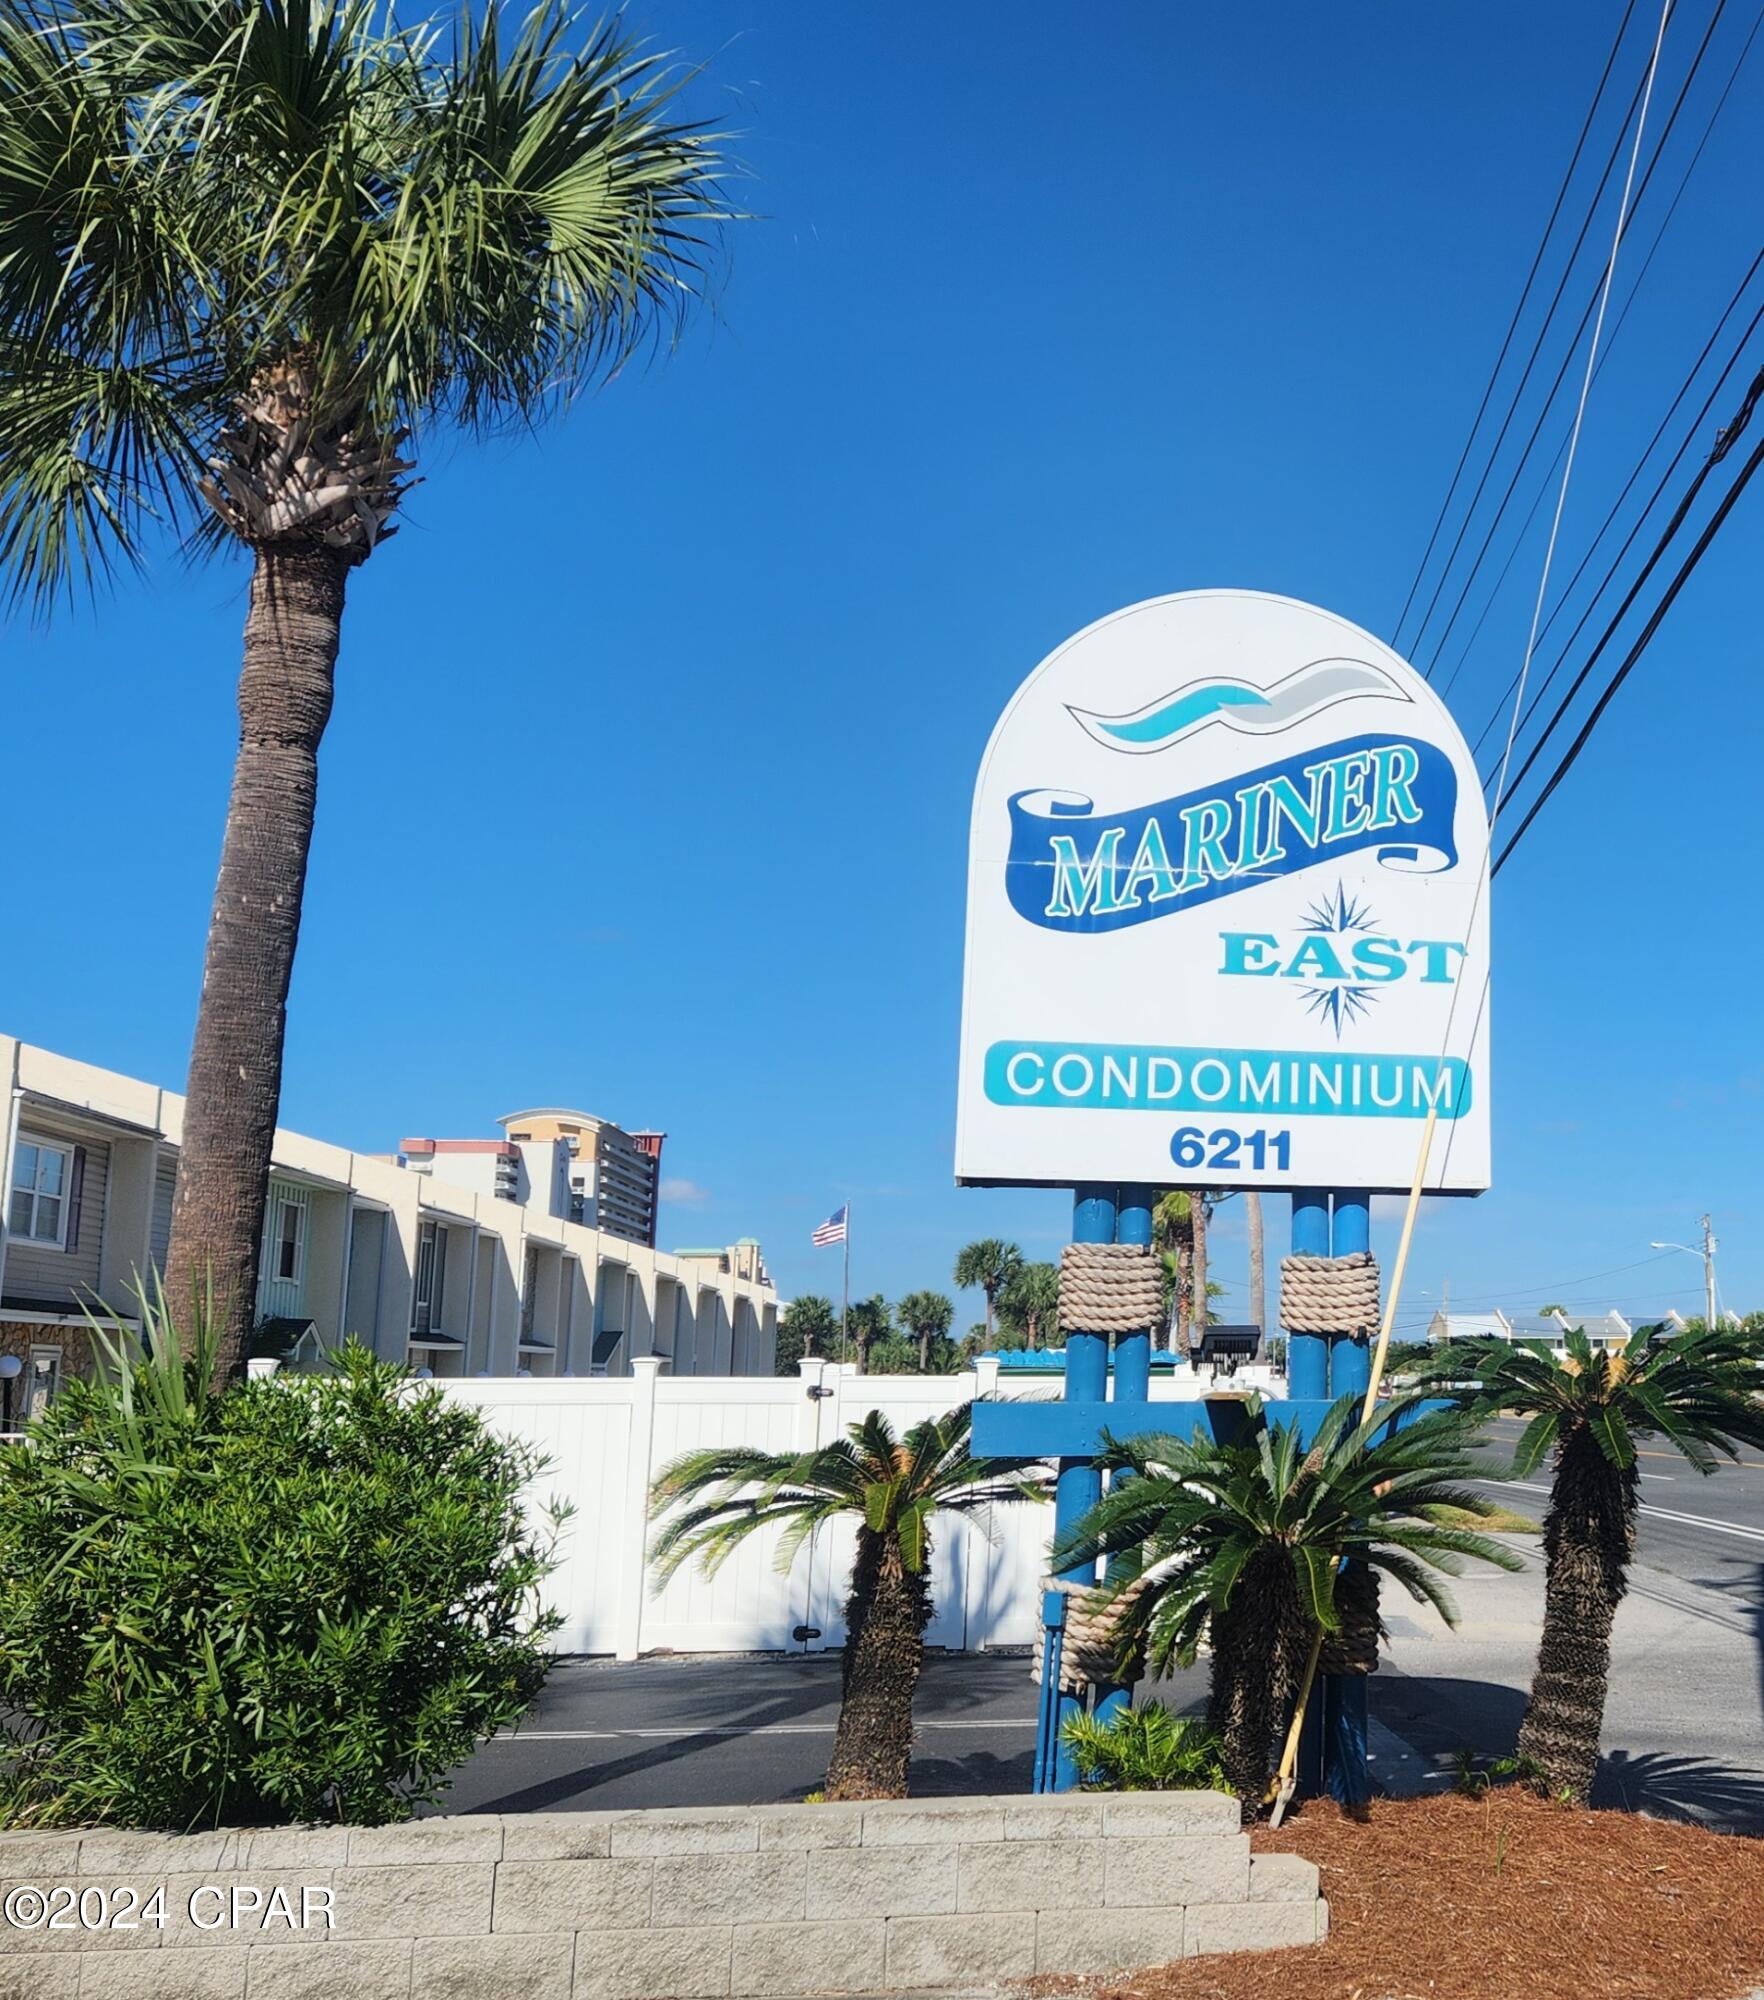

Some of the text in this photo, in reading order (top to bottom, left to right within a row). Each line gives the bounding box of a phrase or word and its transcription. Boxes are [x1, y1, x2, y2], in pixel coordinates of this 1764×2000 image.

[1044, 743, 1424, 918] MARINER
[1217, 933, 1468, 984] EAST
[1006, 1051, 1453, 1108] CONDOMINIUM
[1169, 1127, 1292, 1171] 6211
